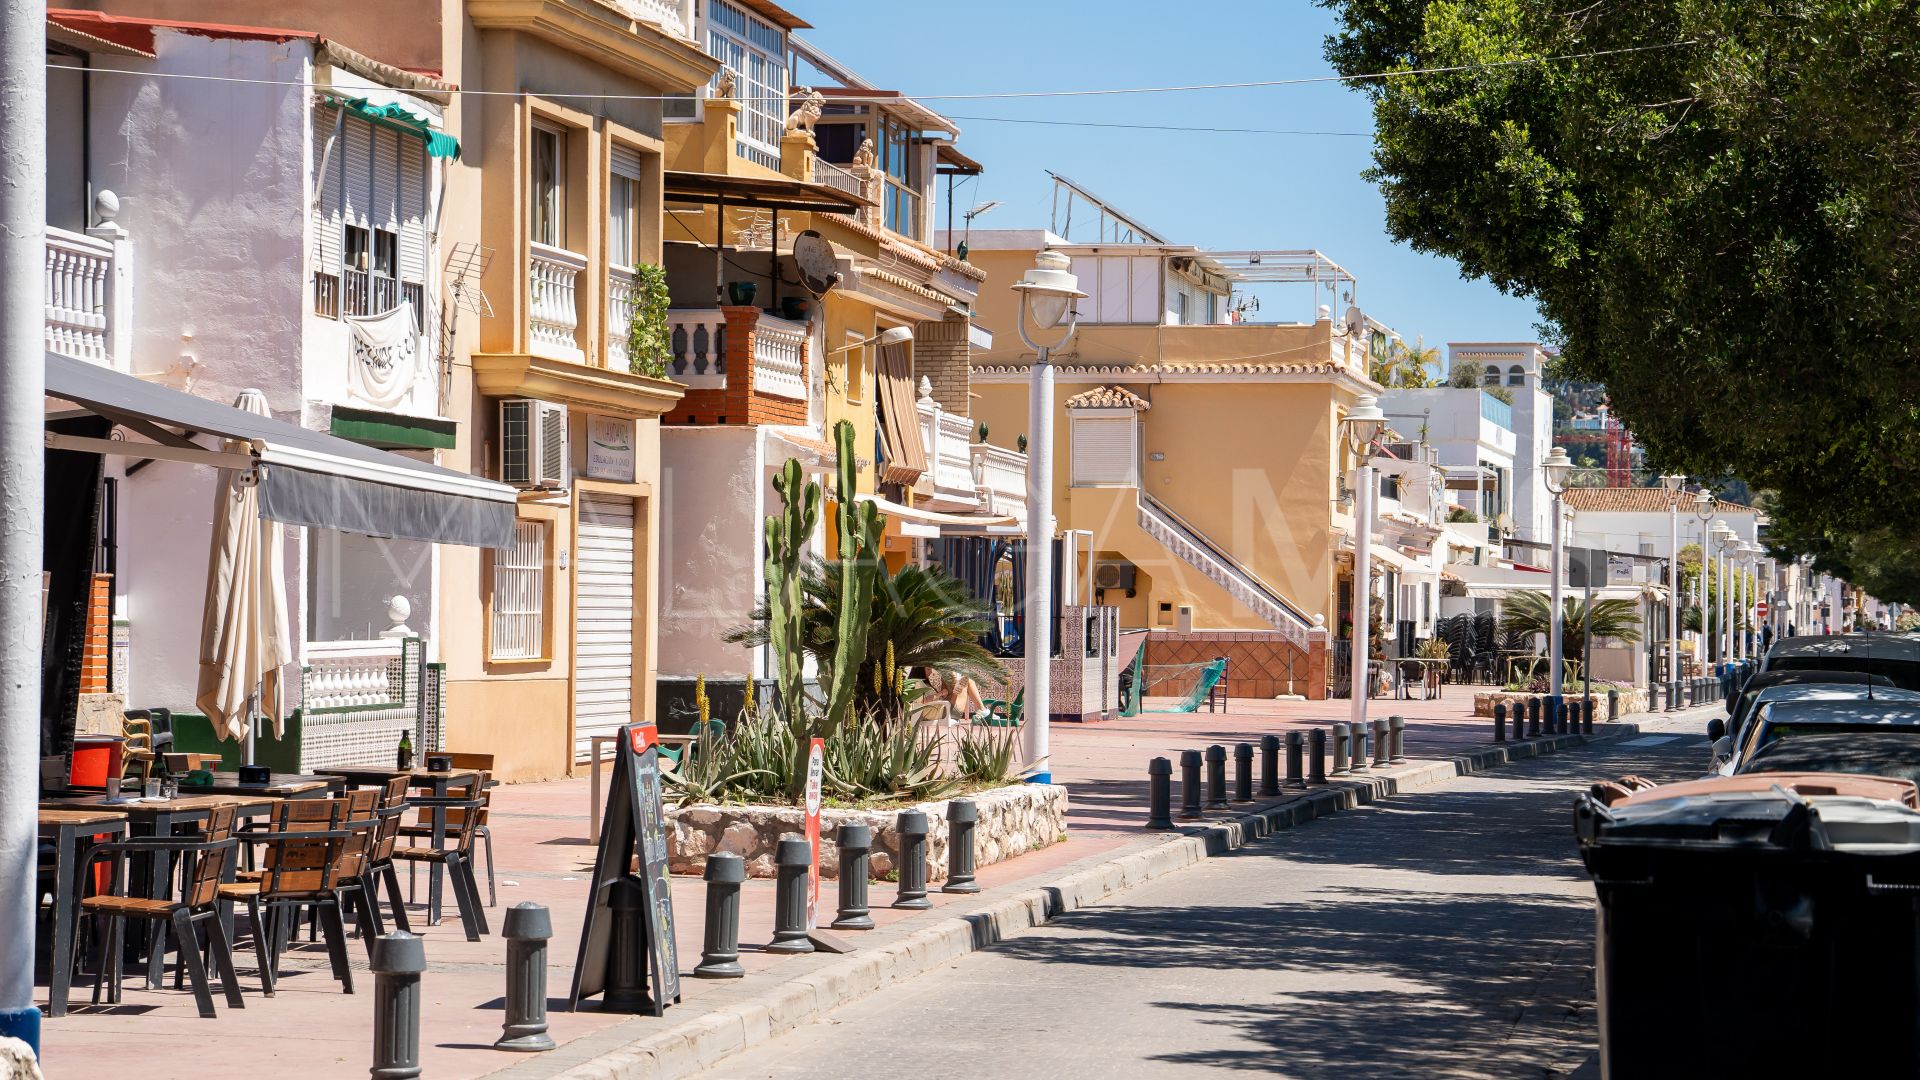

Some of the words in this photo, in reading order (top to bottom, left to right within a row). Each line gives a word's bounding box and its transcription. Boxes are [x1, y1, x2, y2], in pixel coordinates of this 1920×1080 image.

[812, 757, 820, 766] Para
[810, 767, 820, 777] llevar
[809, 779, 819, 790] Take
[808, 791, 818, 801] away
